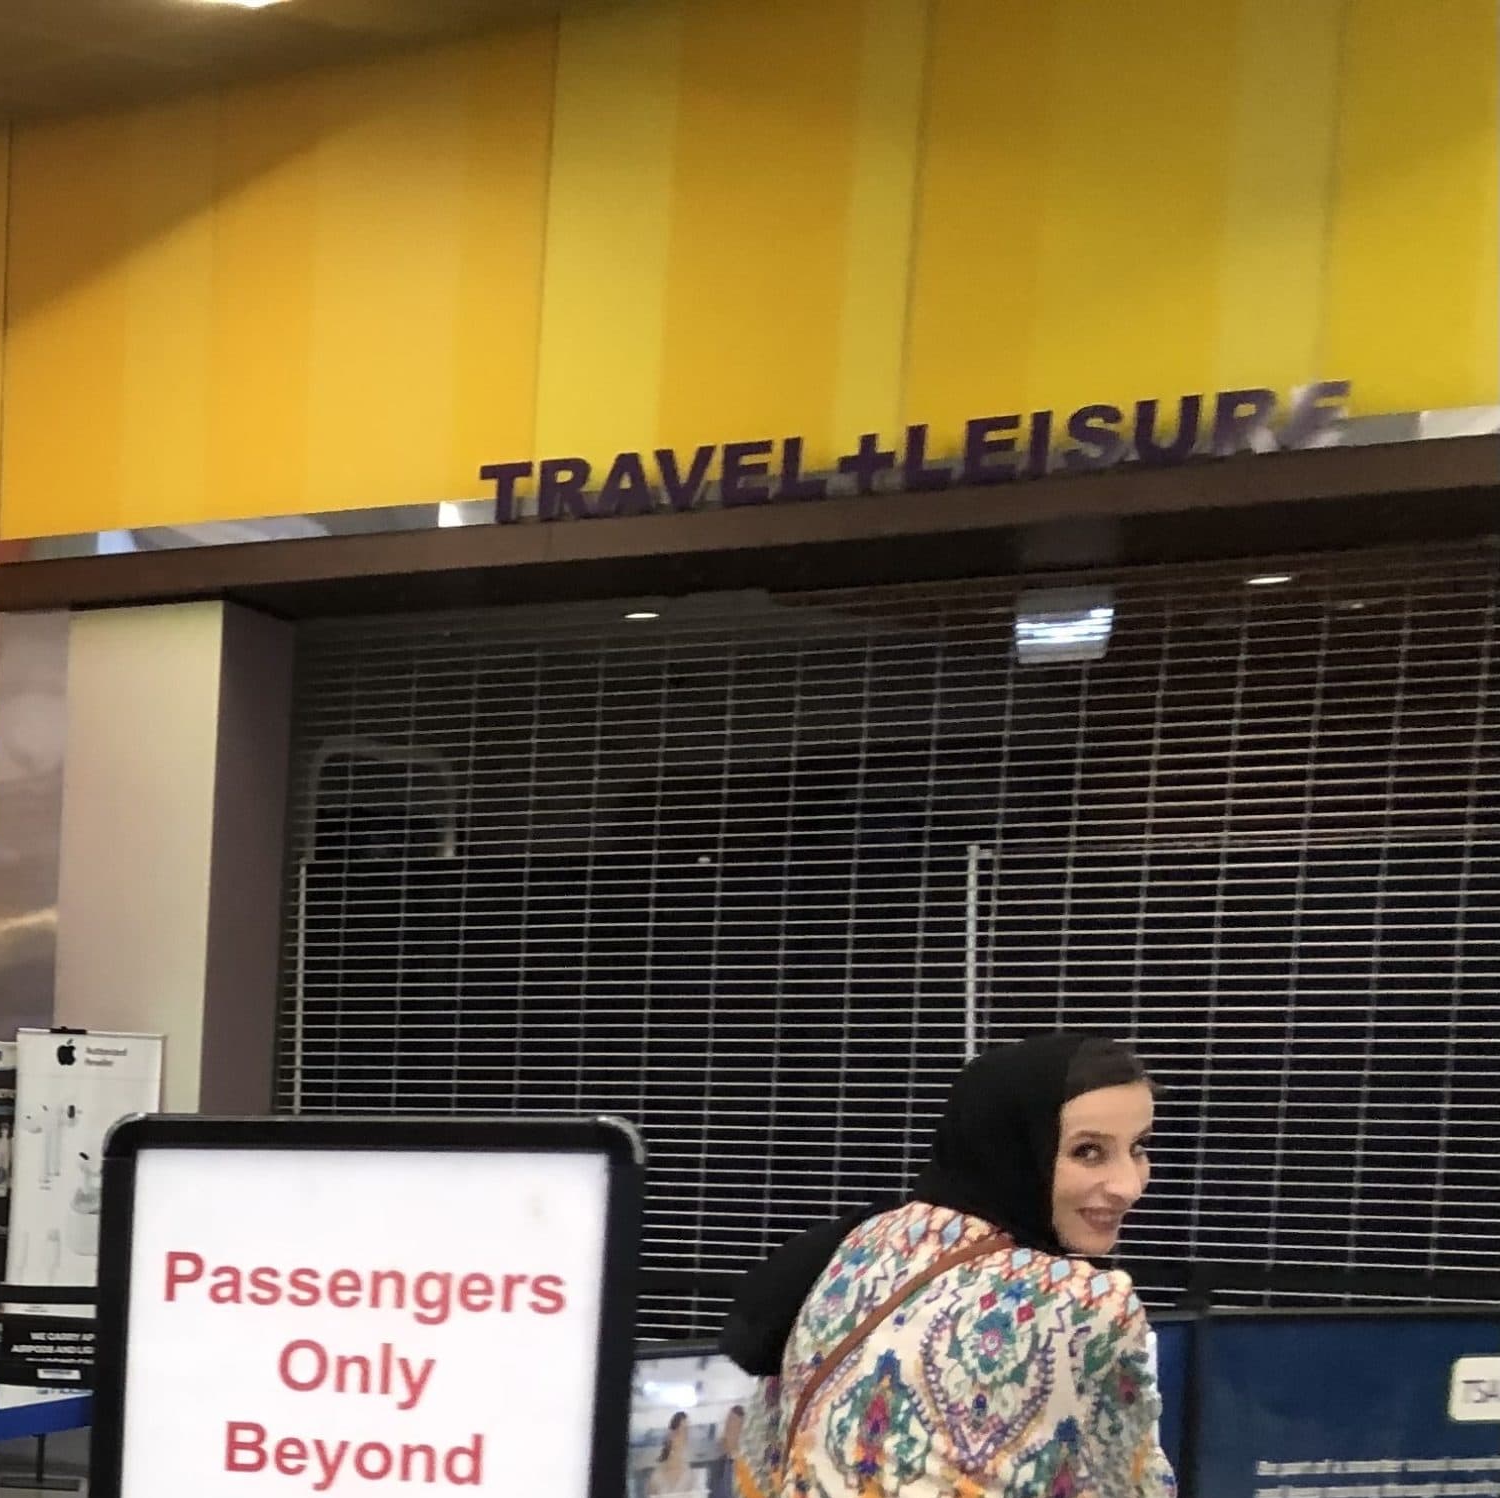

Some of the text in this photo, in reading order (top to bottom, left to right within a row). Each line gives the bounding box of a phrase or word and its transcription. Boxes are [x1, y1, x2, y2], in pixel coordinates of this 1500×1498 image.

[163, 1251, 566, 1325] Passengers
[278, 1339, 435, 1410] Only
[224, 1421, 484, 1491] Beyond
